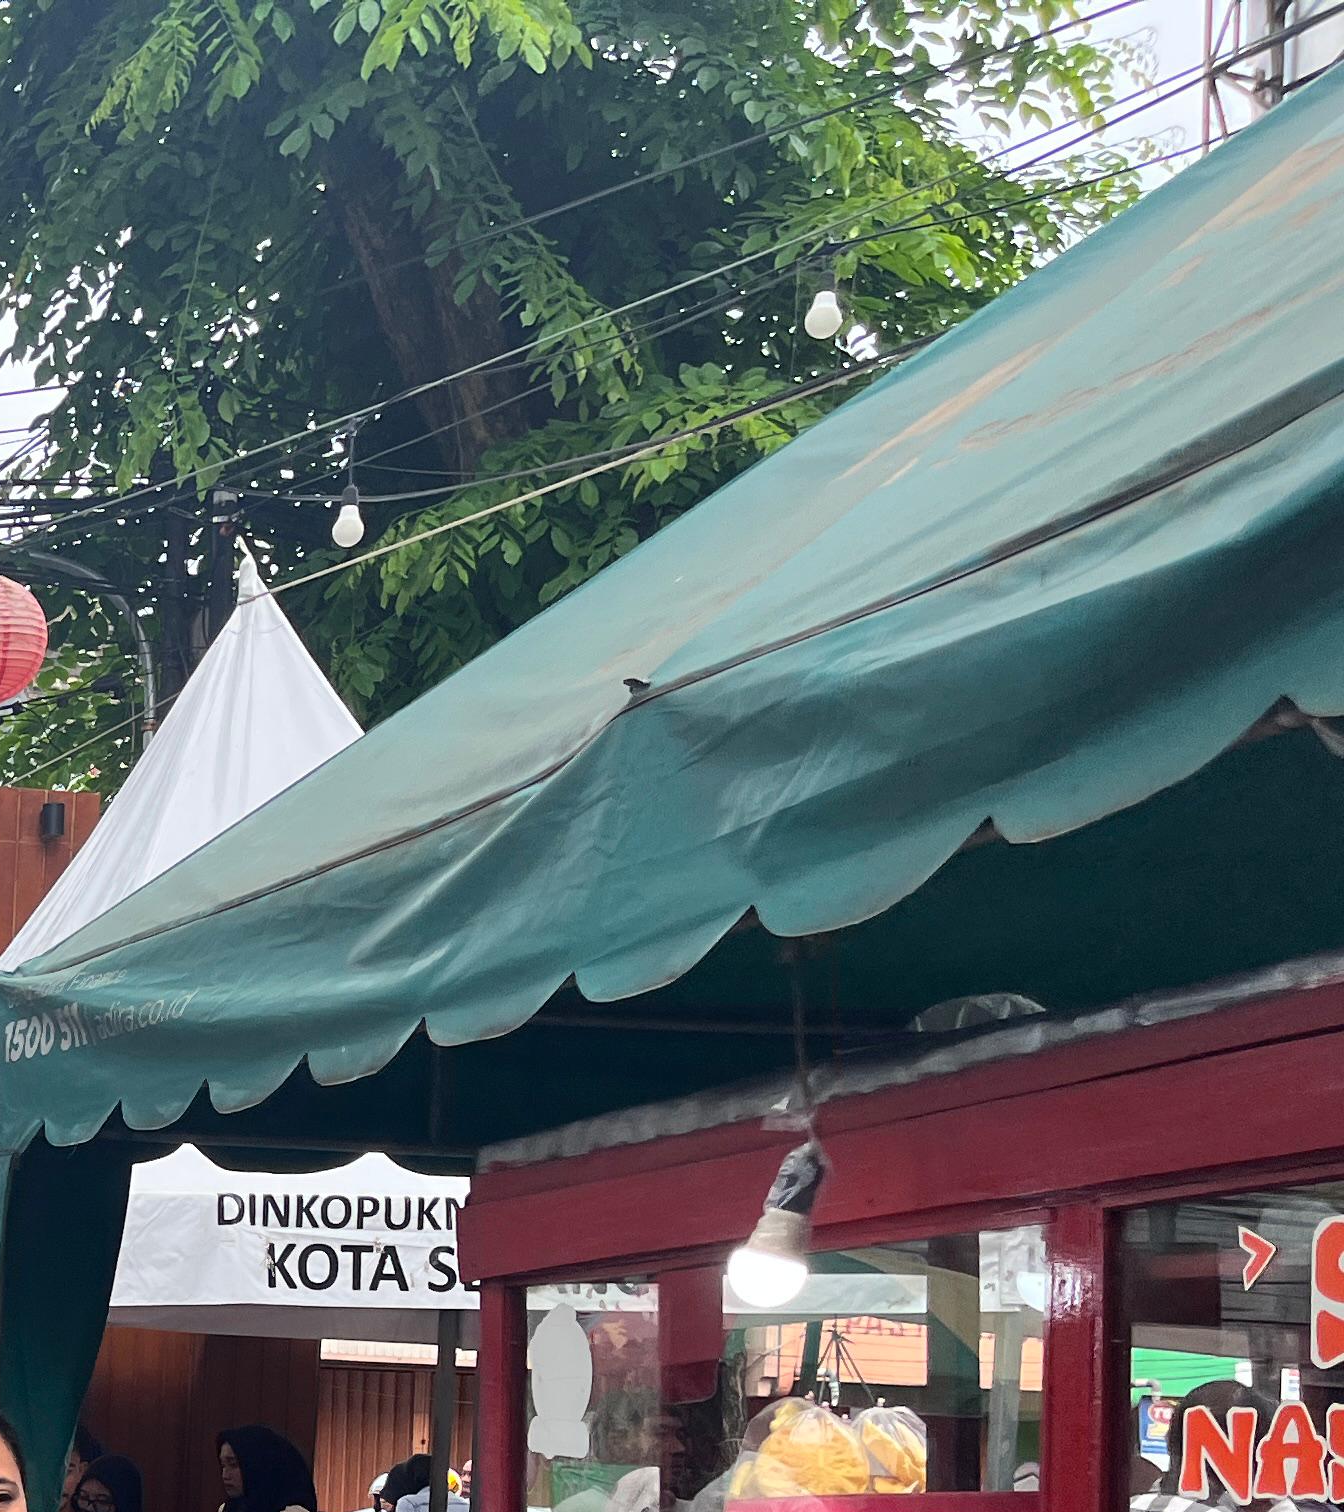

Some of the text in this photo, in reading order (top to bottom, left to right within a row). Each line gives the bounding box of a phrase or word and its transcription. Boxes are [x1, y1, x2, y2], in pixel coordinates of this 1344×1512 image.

[4, 1012, 56, 1063] 1500
[266, 1242, 480, 1293] KOTA S
[1177, 1400, 1344, 1506] NA
